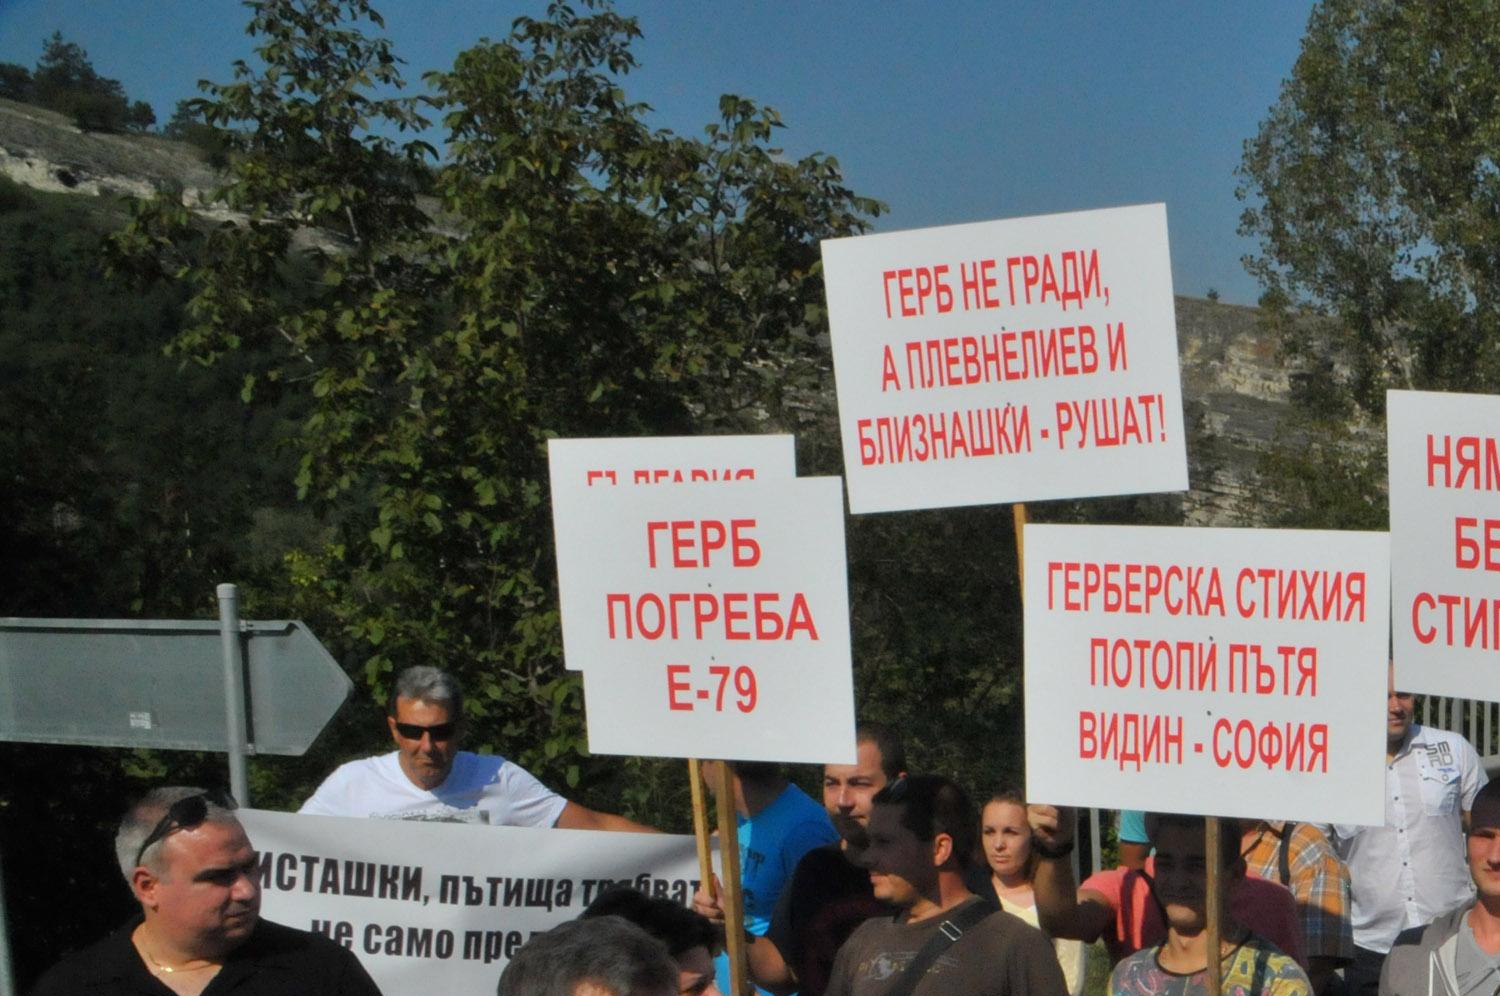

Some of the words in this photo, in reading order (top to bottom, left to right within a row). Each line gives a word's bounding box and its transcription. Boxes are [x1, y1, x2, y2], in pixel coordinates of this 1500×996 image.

[884, 264, 954, 319] ГЕРБ
[960, 258, 1001, 310] НЕ
[1006, 249, 1110, 310] ГРАДИ,
[881, 345, 902, 392] А
[905, 324, 1100, 389] ПЛЕВНЕЛИЕВ
[1107, 322, 1128, 372] И
[856, 404, 1033, 467] БЛИЗНАШКИ
[1055, 394, 1167, 450] РУШАТ!
[646, 519, 762, 569] ГЕРБ
[606, 592, 819, 641] ПОГРЕБА
[1047, 561, 1226, 617] ГЕРБЕРСКА
[1236, 567, 1367, 623] СТИХИЯ
[666, 664, 758, 714] Е-79
[1089, 637, 1219, 692] ПОТОПИ
[1228, 643, 1319, 698] ПЪТЯ
[1078, 711, 1184, 772] ВИДИН
[1211, 718, 1329, 774] СОФИЯ
[255, 850, 430, 906] ИСТАШКИ,
[439, 874, 574, 912] пътища
[363, 923, 454, 960] само
